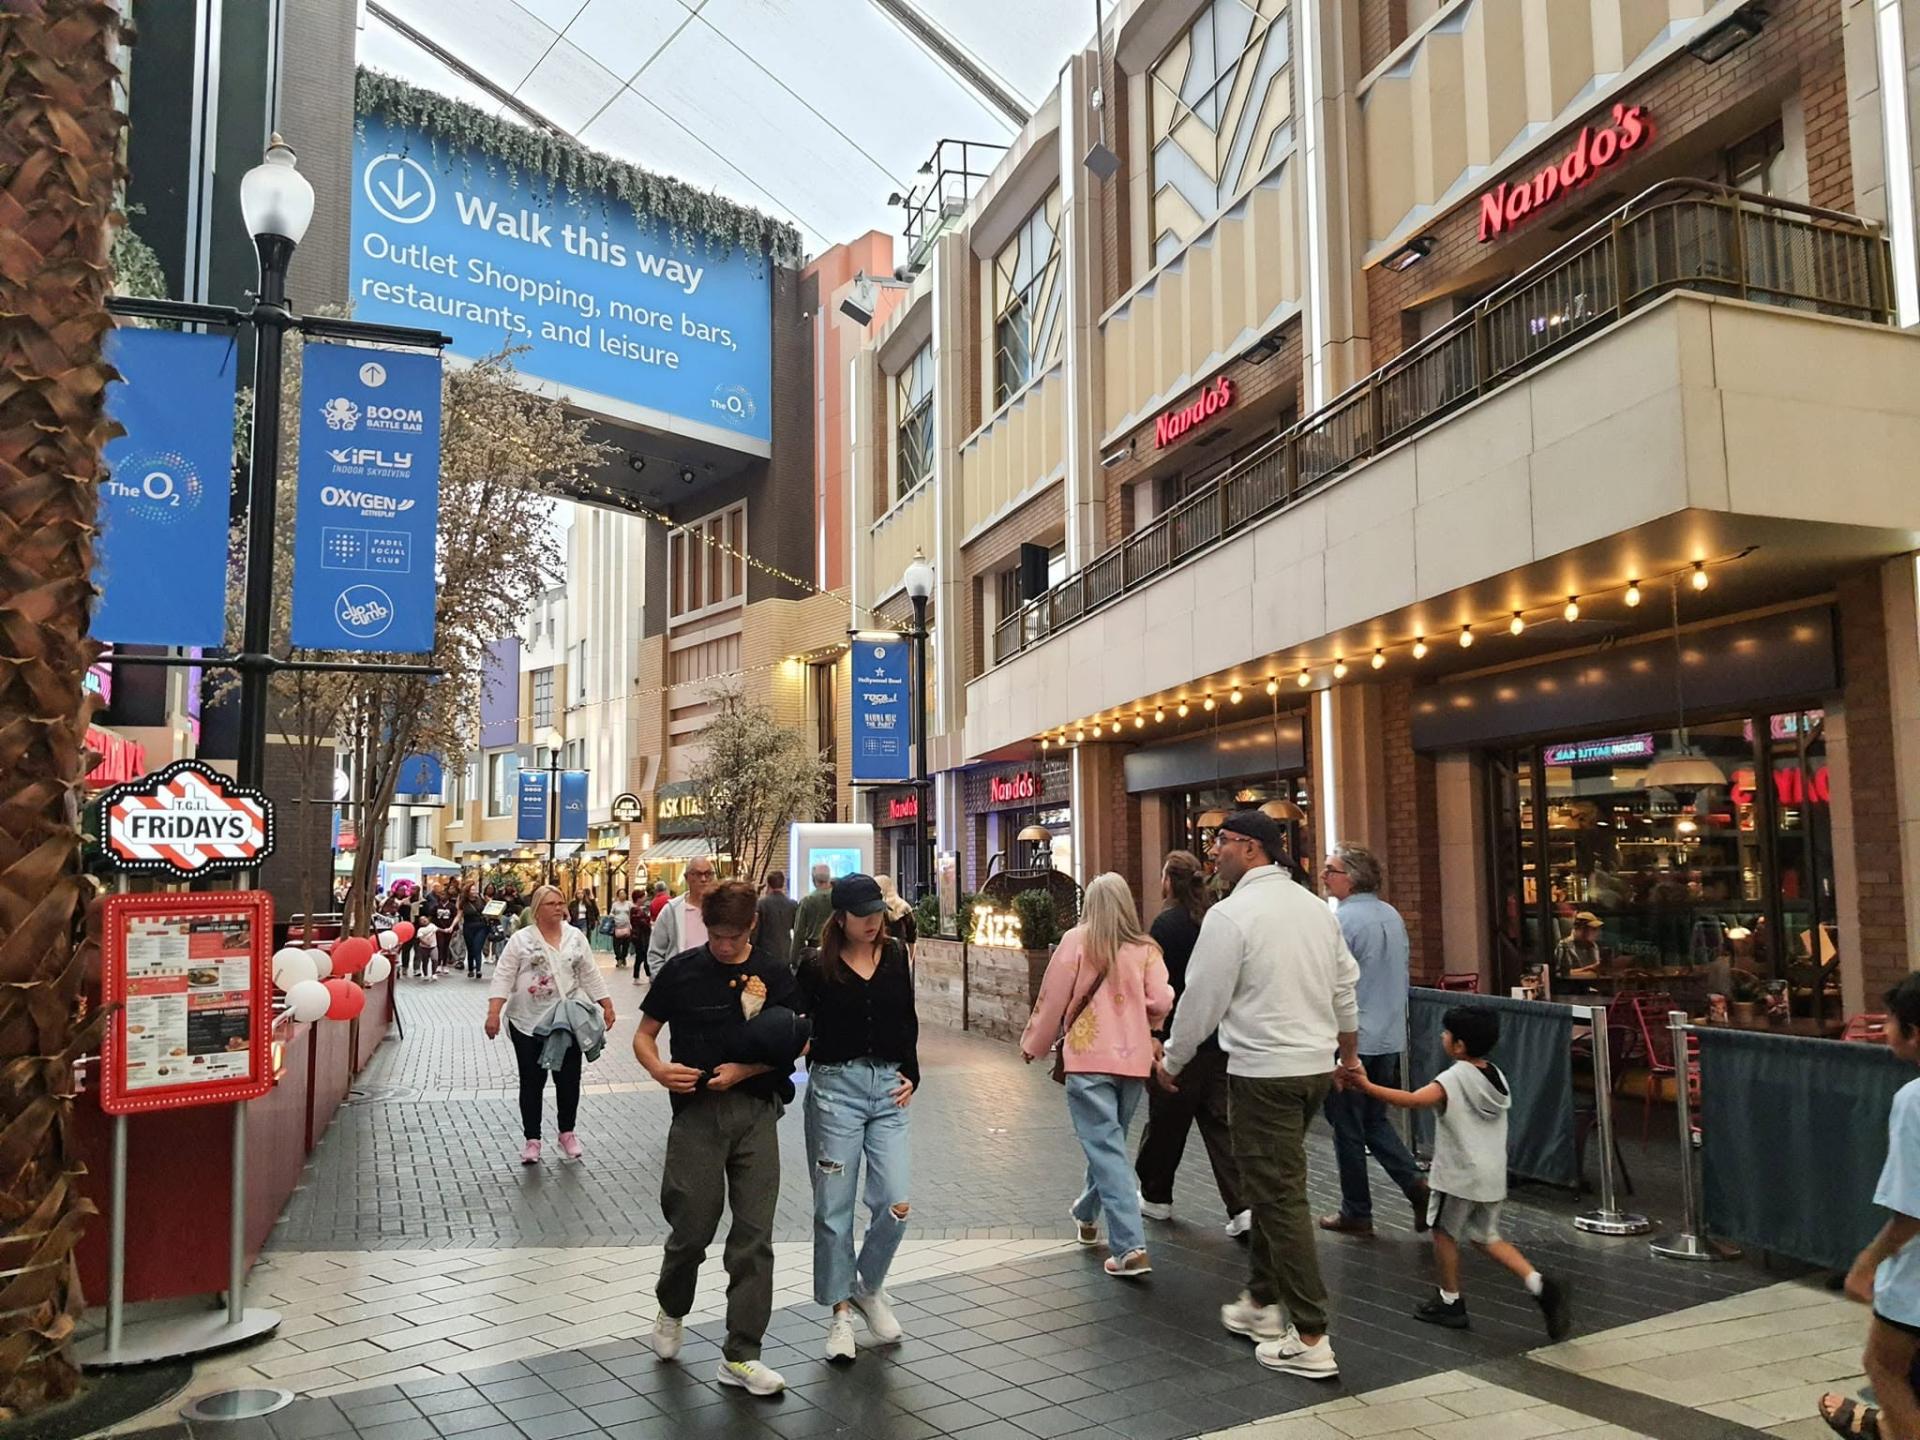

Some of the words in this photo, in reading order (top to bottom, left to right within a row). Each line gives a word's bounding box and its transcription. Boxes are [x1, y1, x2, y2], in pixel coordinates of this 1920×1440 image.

[1478, 103, 1642, 243] Nando's
[455, 191, 552, 248] Walk
[561, 223, 627, 268] this
[635, 250, 704, 295] way
[363, 232, 459, 279] Outlet
[467, 258, 601, 318] Shopping,
[609, 300, 674, 332] more
[681, 312, 737, 352] bars,
[361, 277, 533, 339] restaurants,
[541, 320, 591, 349] and
[600, 328, 680, 370] leisure
[710, 398, 727, 410] The
[1154, 376, 1231, 450] Nando's
[366, 405, 424, 423] BOOM
[366, 419, 401, 430] BATTLE
[402, 422, 423, 432] BAR
[332, 464, 365, 476] INDOOR
[366, 467, 412, 479] SKYDIVING
[108, 481, 141, 498] The
[320, 485, 397, 511] OXYGEN
[371, 547, 406, 556] SOCIAL
[373, 538, 404, 547] PADEL
[375, 556, 401, 564] CLUB
[991, 771, 1034, 802] Nando's
[659, 797, 679, 818] ASK
